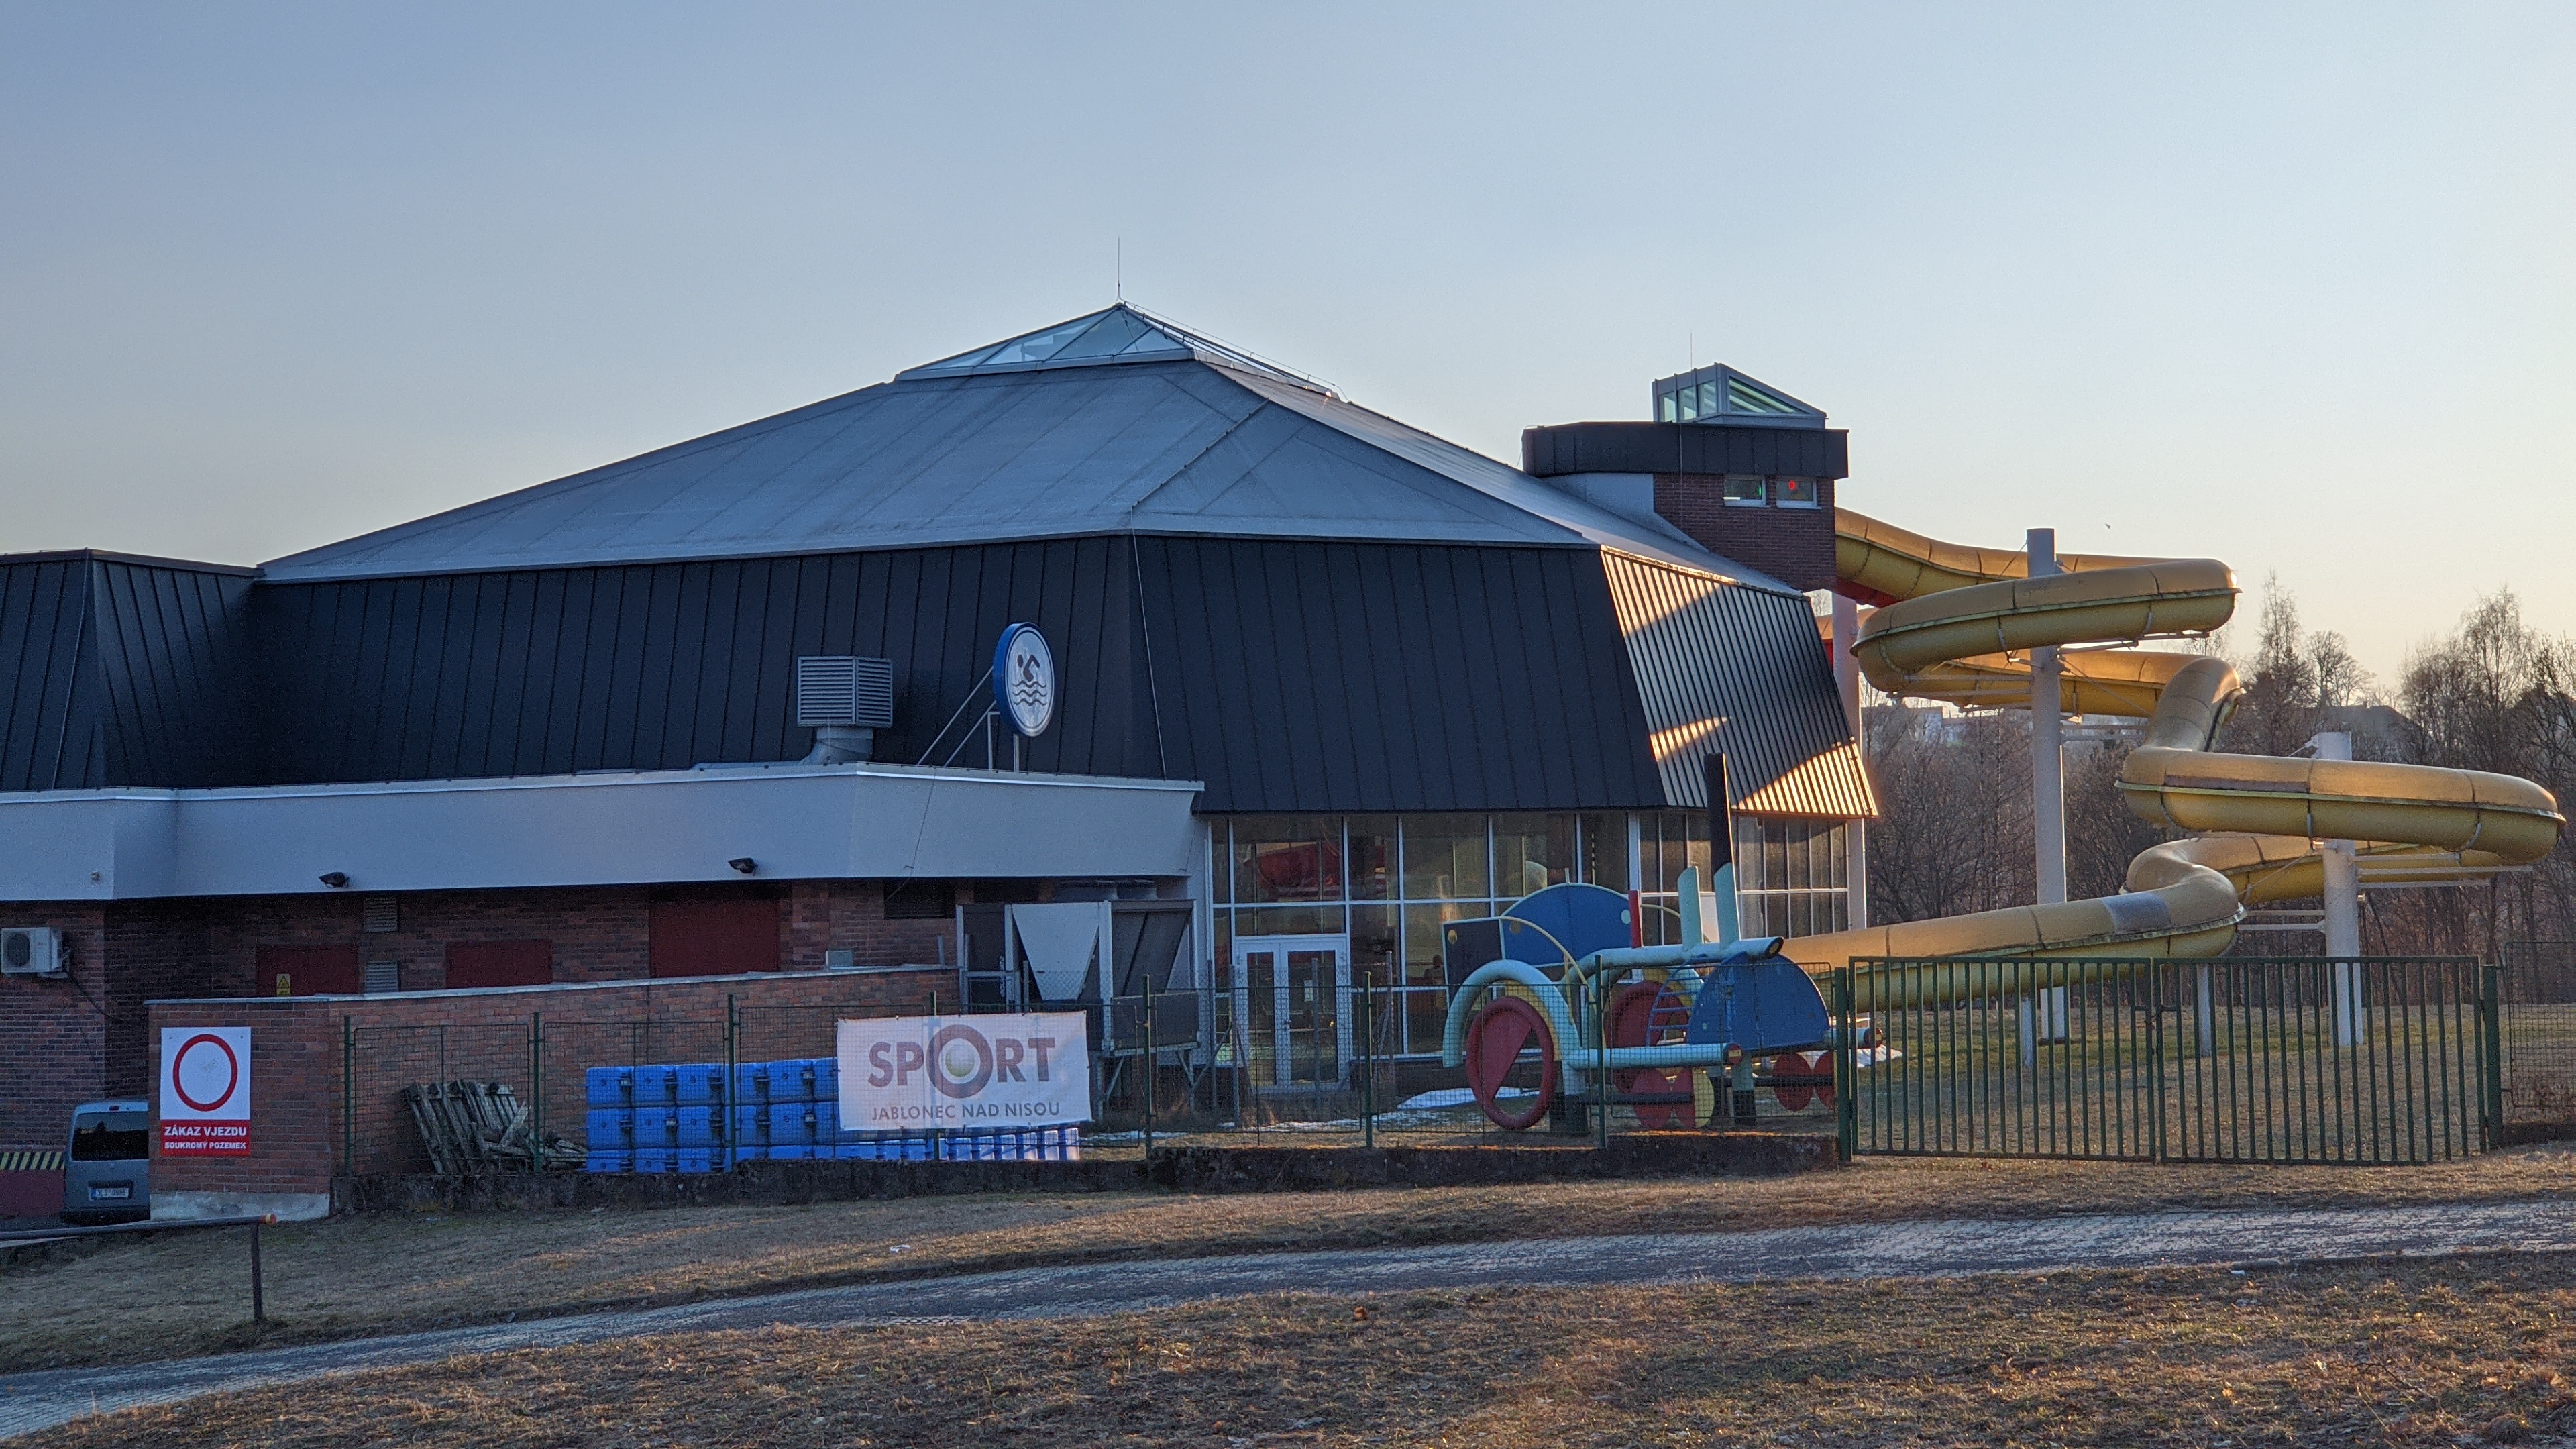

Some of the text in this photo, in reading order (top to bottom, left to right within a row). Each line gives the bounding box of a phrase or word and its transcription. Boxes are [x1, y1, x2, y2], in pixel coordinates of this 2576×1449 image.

[868, 1024, 1055, 1099] SPORT
[872, 1102, 1060, 1120] JABLONEC NAD NISOU
[164, 1124, 247, 1137] ZÁKAZ VJEZDU
[164, 1140, 247, 1150] SOUKROMÝ POZEMEK
